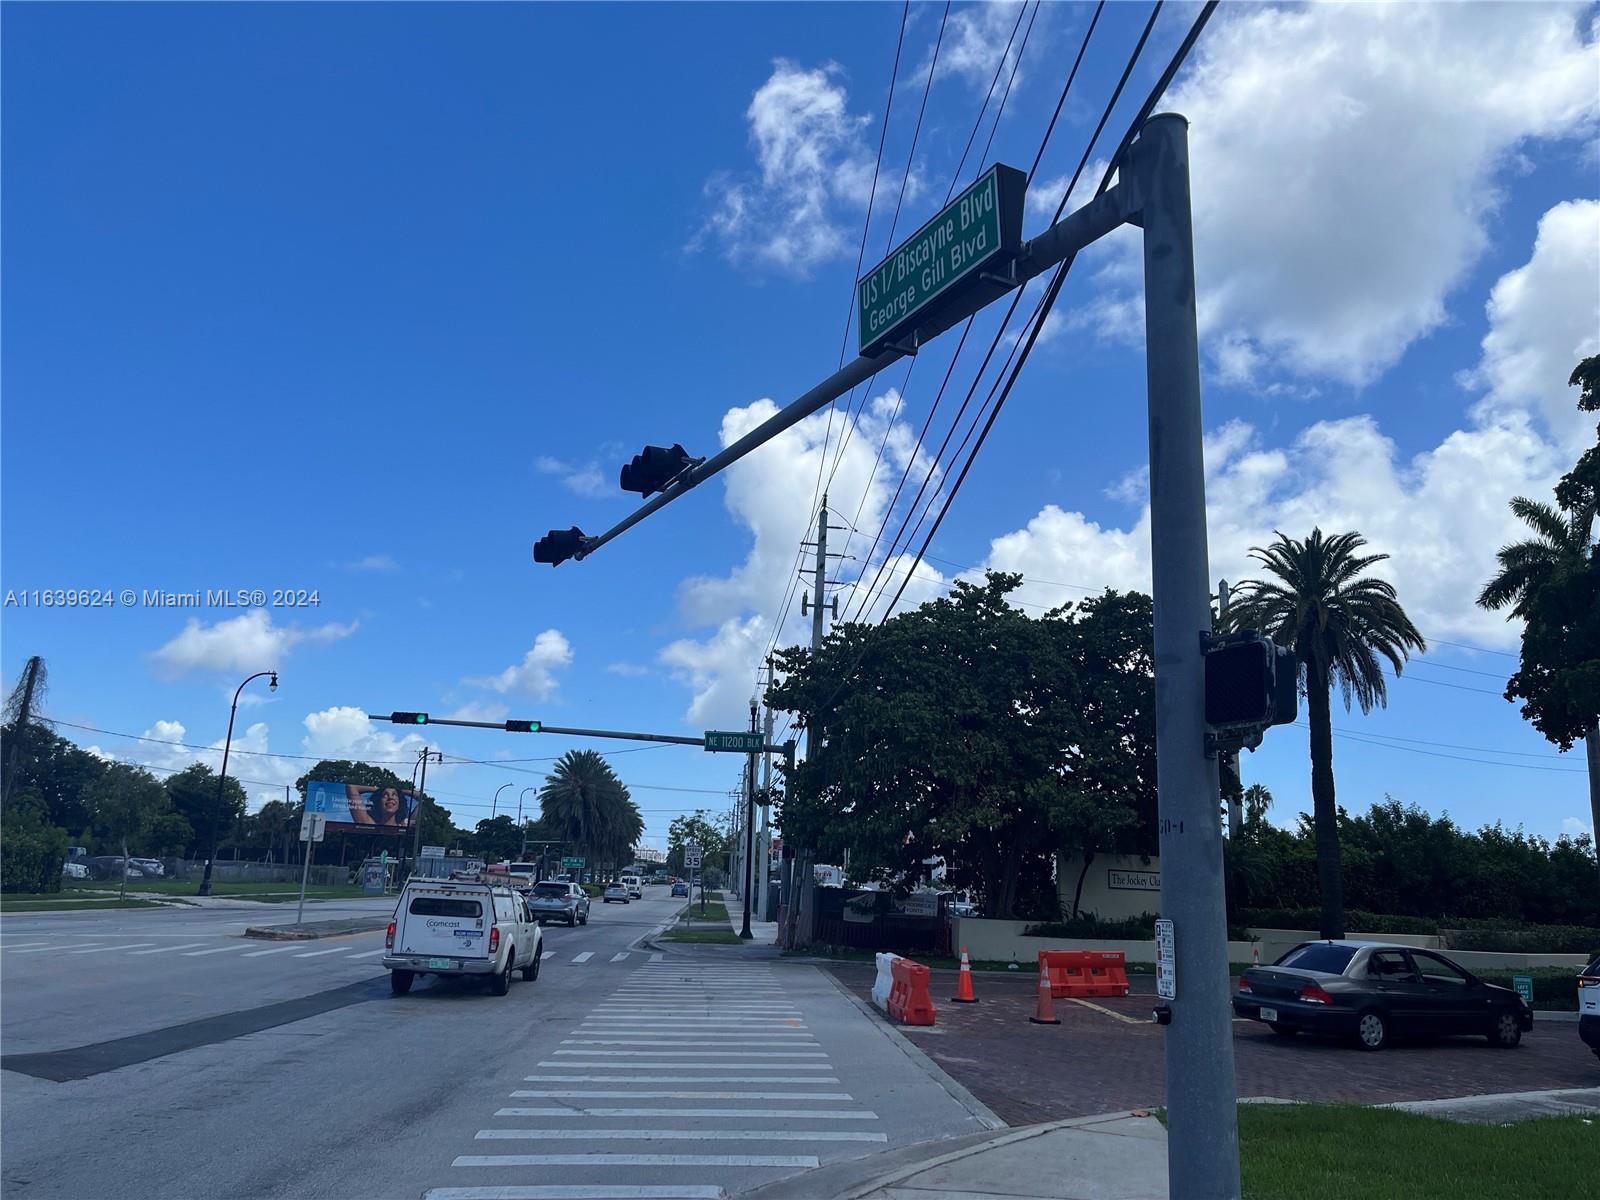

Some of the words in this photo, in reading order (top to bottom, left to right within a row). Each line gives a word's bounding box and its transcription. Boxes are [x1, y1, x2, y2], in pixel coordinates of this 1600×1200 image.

[862, 276, 878, 310] US
[882, 219, 954, 294] 1/Biscayne
[960, 179, 993, 231] Blvd
[869, 285, 916, 332] George
[921, 256, 945, 292] Gill
[951, 225, 987, 271] Blvd
[708, 736, 718, 746] NE
[722, 736, 744, 748] 11200
[685, 857, 700, 866] 35
[1112, 873, 1126, 885] The
[1126, 874, 1148, 888] Jockey
